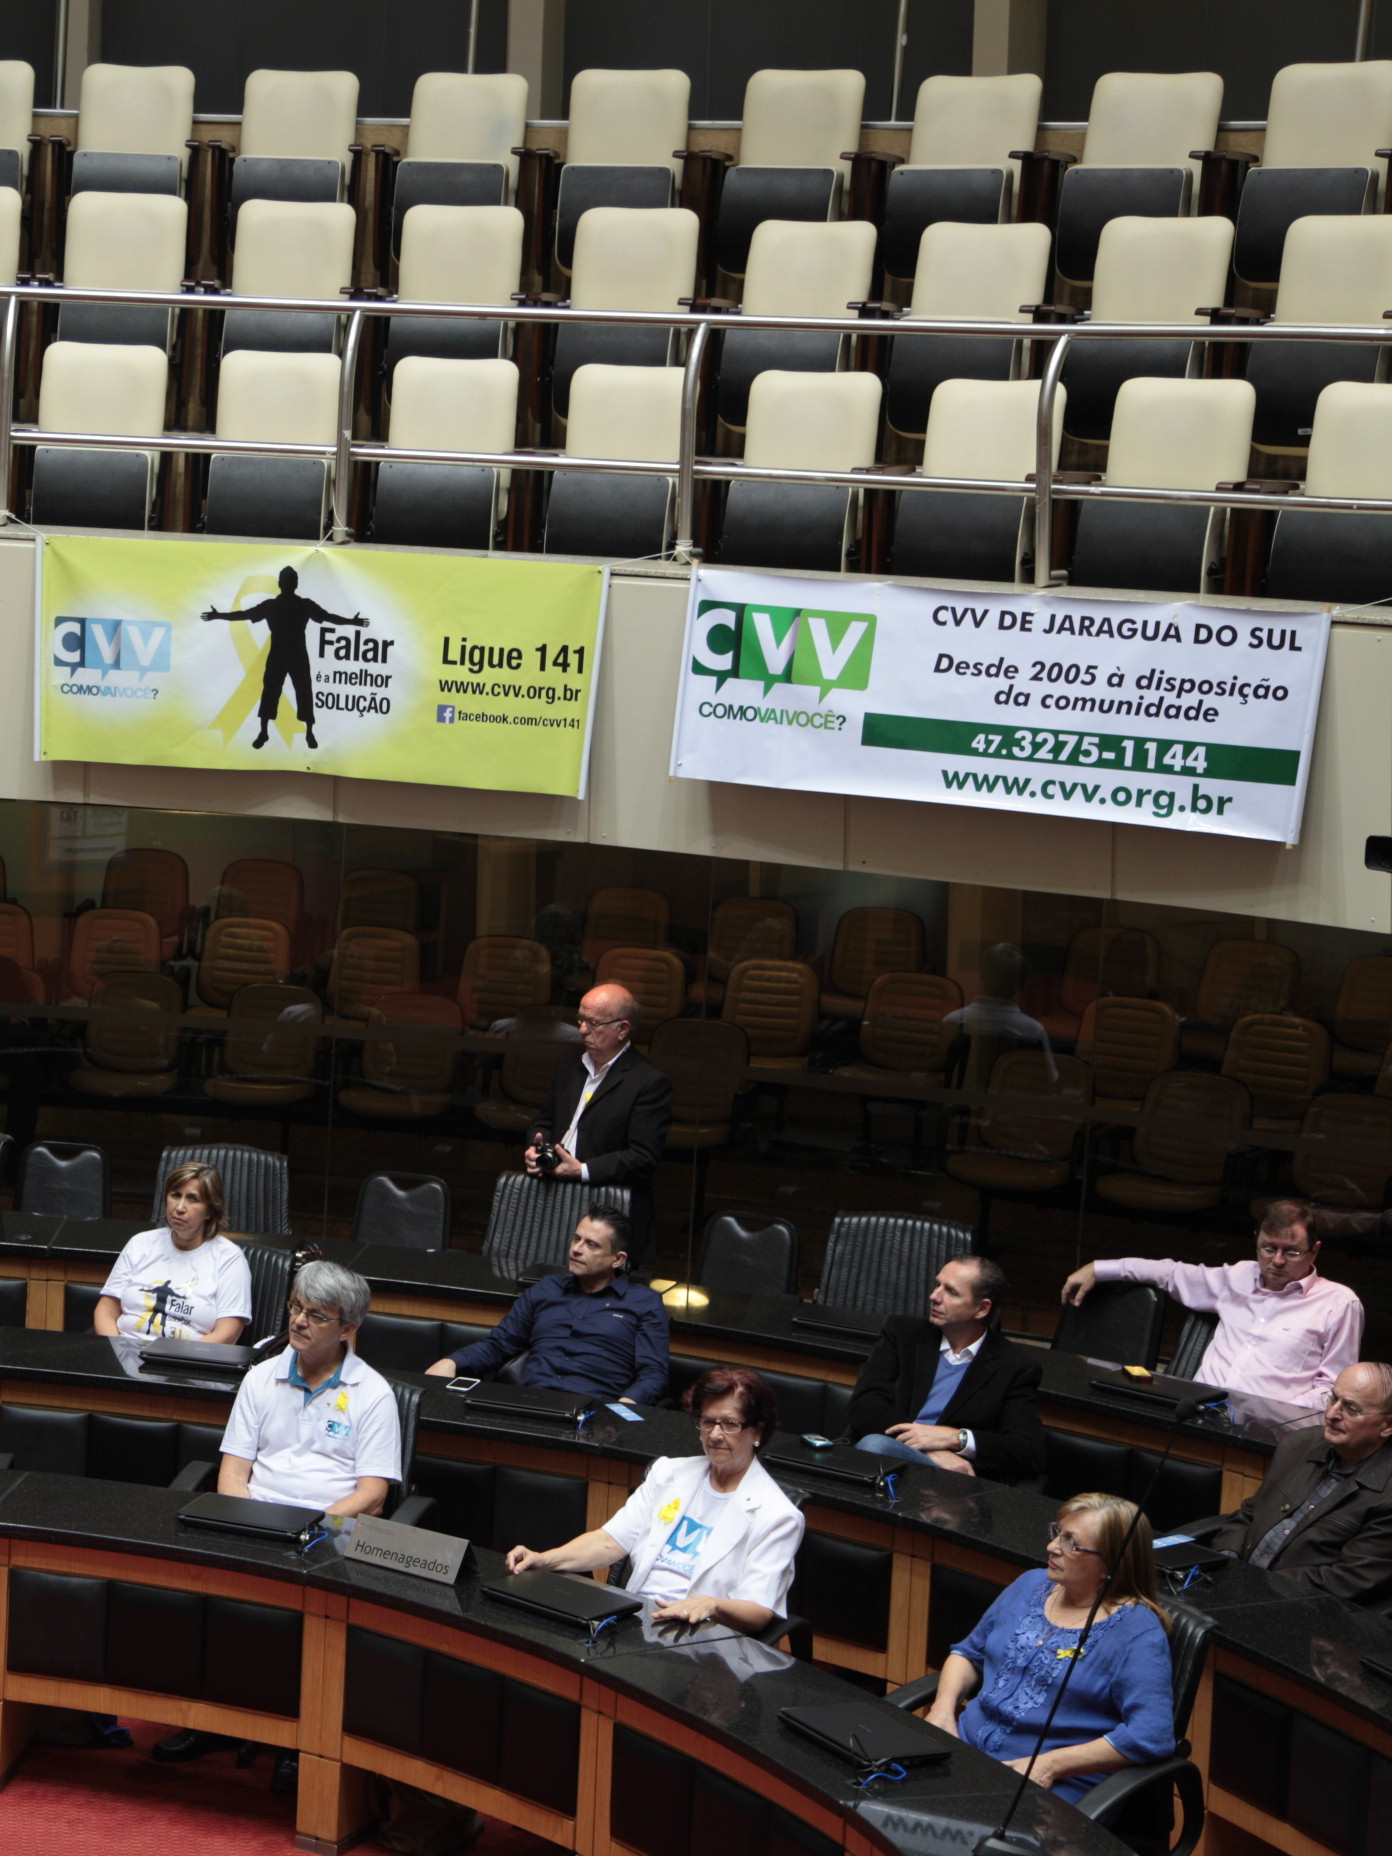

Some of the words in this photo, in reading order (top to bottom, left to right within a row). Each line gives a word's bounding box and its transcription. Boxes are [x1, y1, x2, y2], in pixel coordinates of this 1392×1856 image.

[54, 621, 167, 667] CVV
[319, 627, 394, 664] Falar
[693, 608, 869, 680] CVV
[932, 605, 990, 628] CVV
[998, 610, 1034, 632] DE
[1193, 623, 1238, 647] DO
[1248, 627, 1303, 652] SUL
[442, 636, 523, 674] Ligue
[535, 643, 586, 674] 141
[332, 668, 393, 688] melhor
[439, 679, 582, 705] www.cvv.org.br
[933, 653, 1020, 680] Desde
[1028, 660, 1099, 686] 2005
[1106, 665, 1126, 688] à
[1135, 668, 1289, 705] disposição
[314, 691, 391, 718] SOLUÇÃO
[458, 709, 581, 730] facebook.com/cvv141
[994, 684, 1031, 707] da
[1040, 693, 1219, 723] comunidade
[941, 769, 1234, 819] www.cvv.org.br
[169, 1298, 195, 1316] Falar
[354, 1540, 450, 1575] Homenageados
